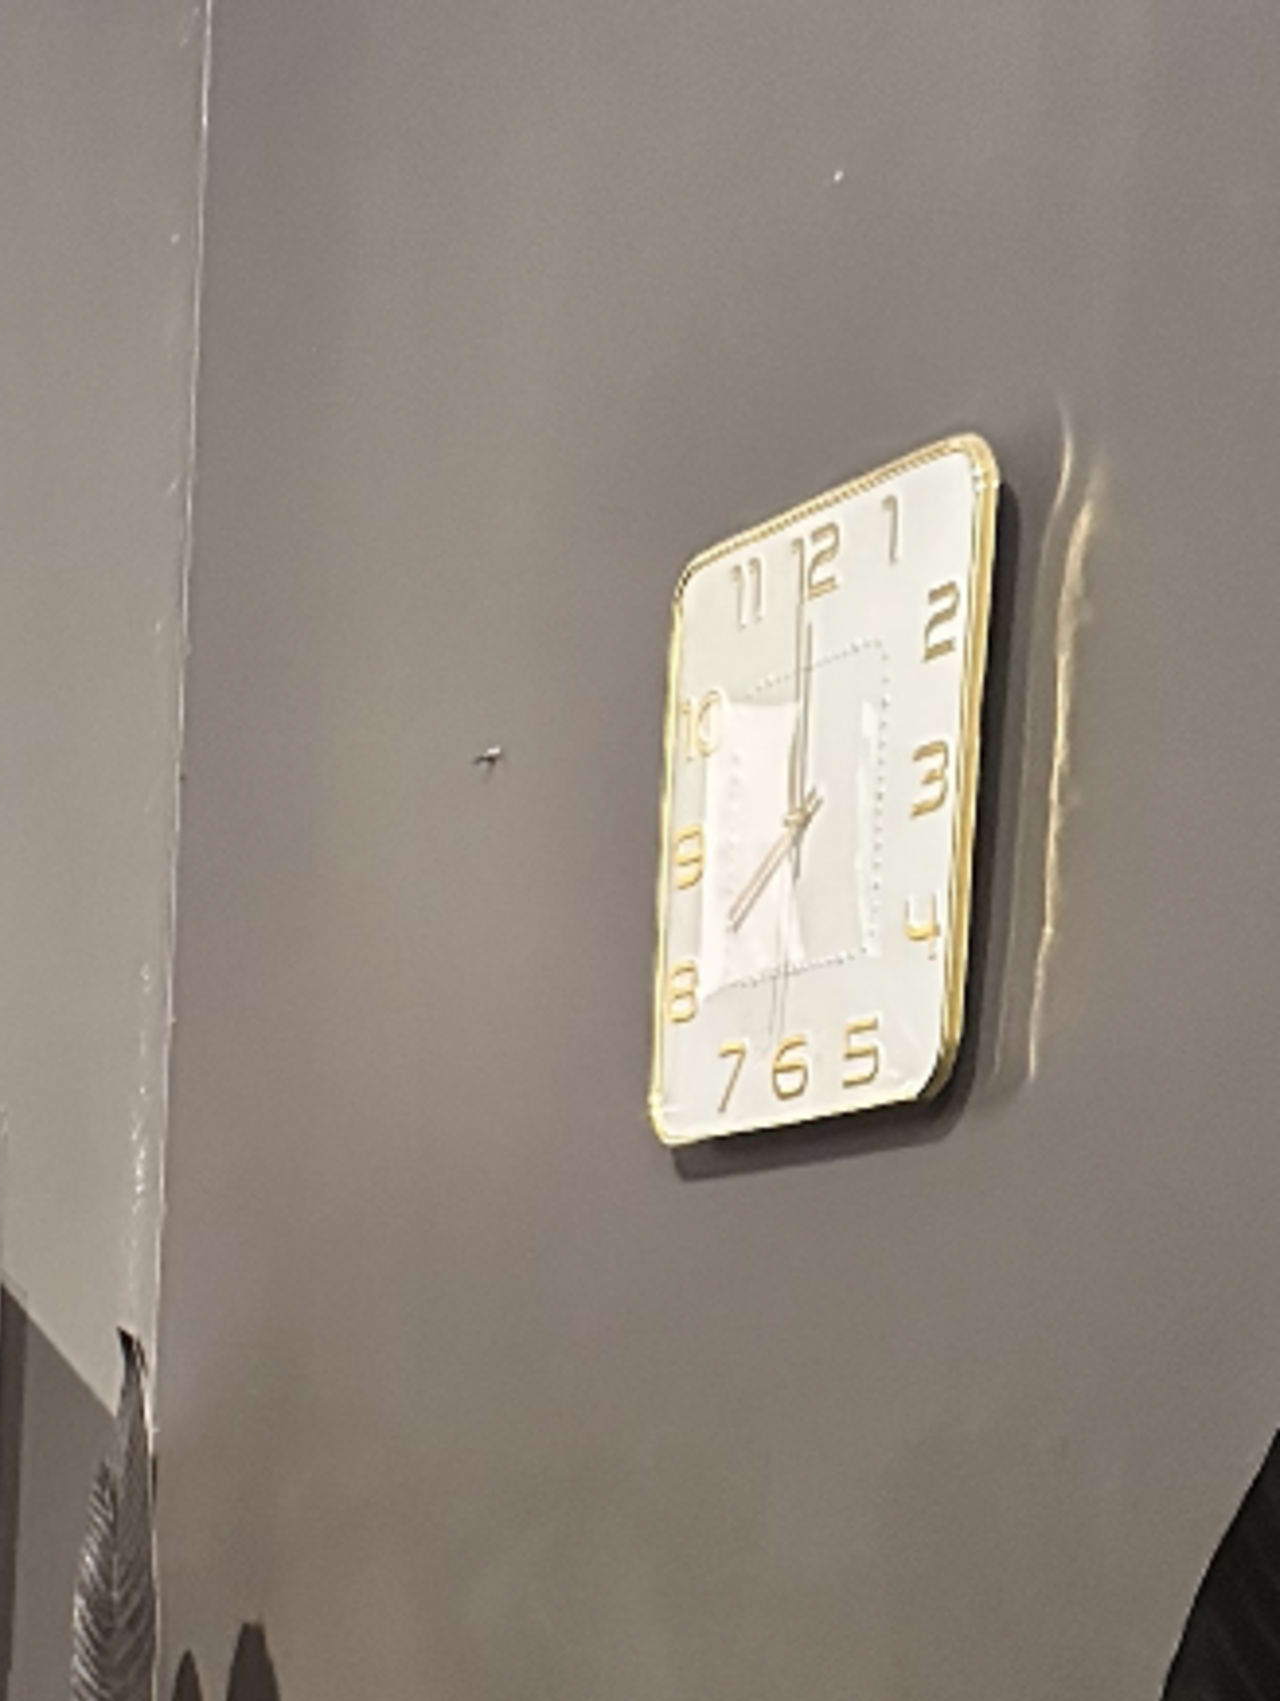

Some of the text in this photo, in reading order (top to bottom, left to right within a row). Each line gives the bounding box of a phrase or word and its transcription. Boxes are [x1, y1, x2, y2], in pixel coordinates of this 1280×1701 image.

[791, 521, 841, 601] 12
[882, 494, 900, 567] 1
[731, 555, 764, 632] 11
[922, 580, 961, 664] 2
[680, 689, 725, 765] 10
[910, 740, 950, 820] 3
[671, 824, 704, 892] 9
[904, 890, 942, 963] 4
[666, 960, 700, 1025] 8
[716, 1043, 748, 1115] 7
[770, 1035, 809, 1102] 6
[840, 1018, 881, 1089] 5
